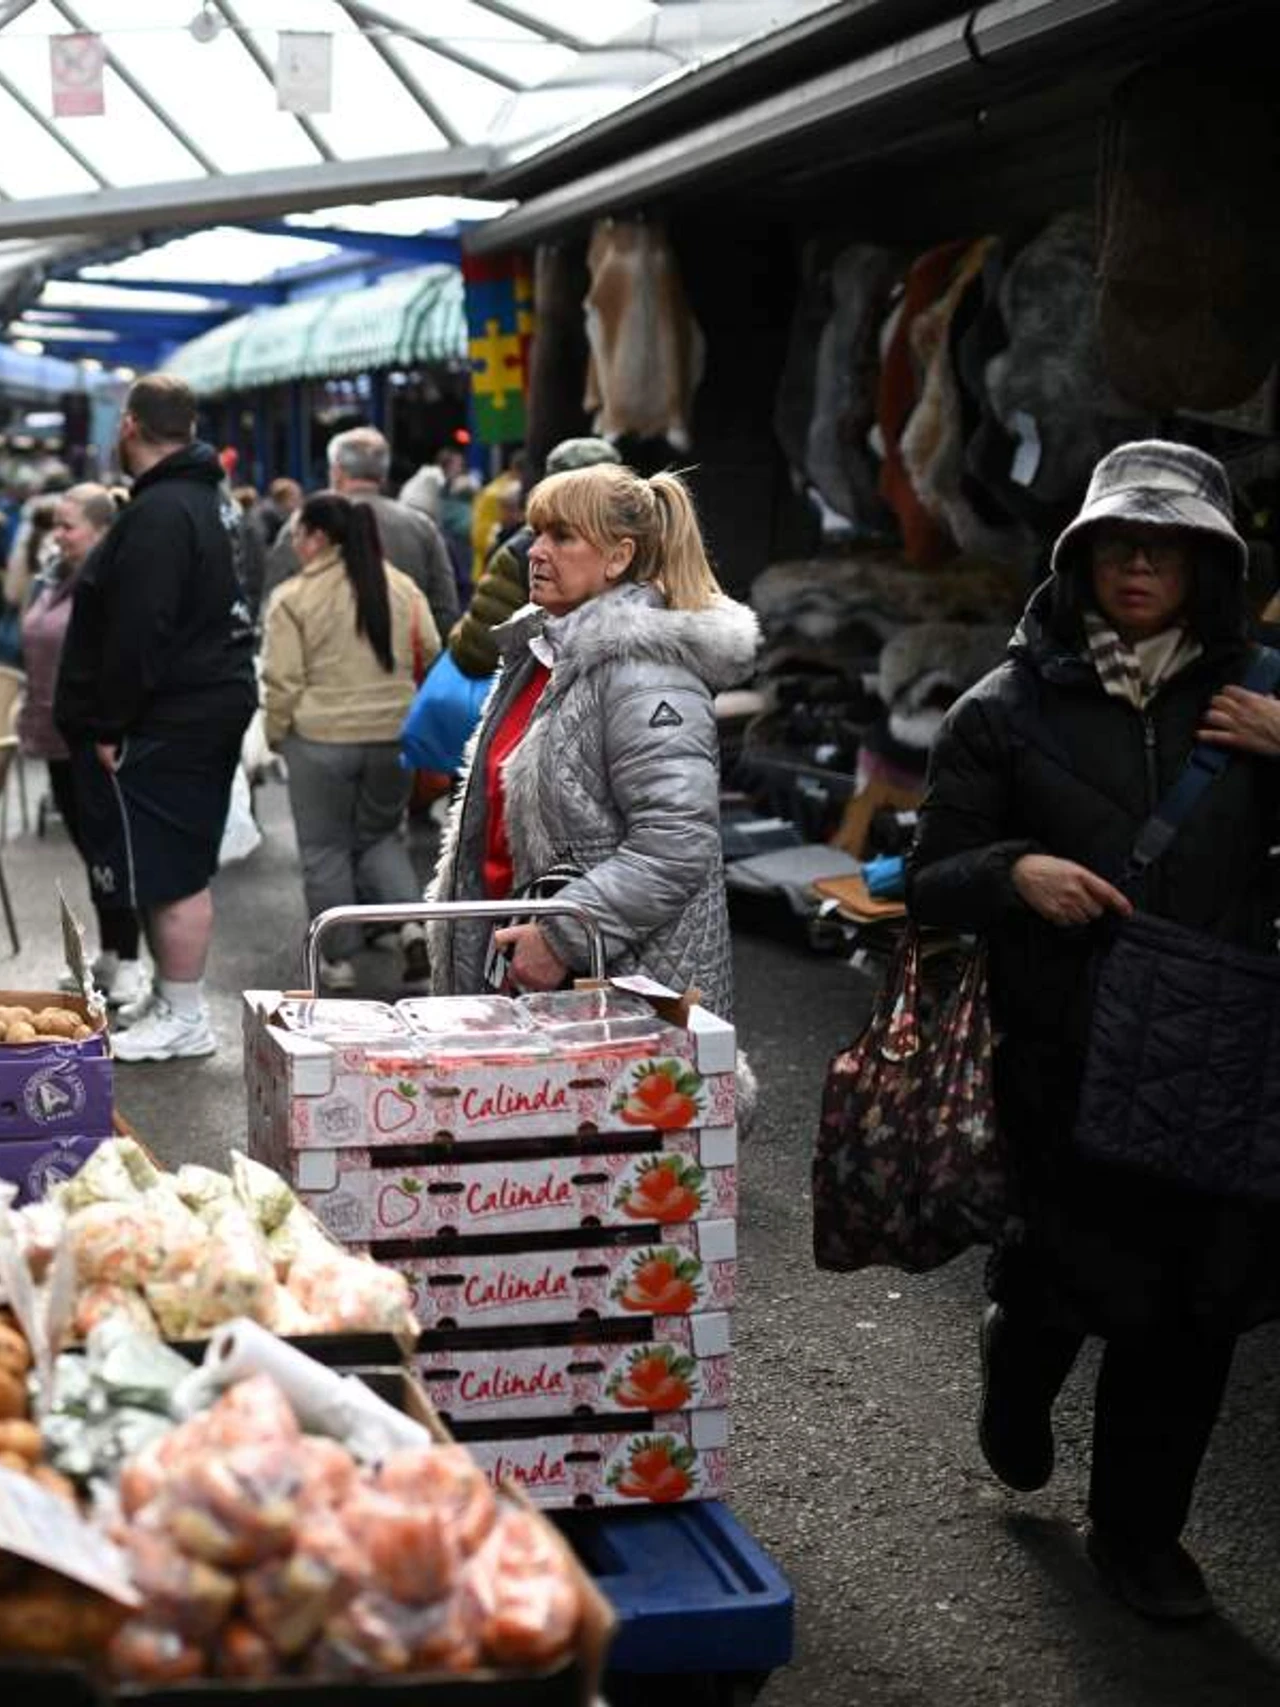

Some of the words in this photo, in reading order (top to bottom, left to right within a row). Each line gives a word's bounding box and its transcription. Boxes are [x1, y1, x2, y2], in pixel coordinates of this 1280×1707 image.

[463, 1079, 567, 1120] Calinda
[467, 1174, 571, 1214] Calinda
[465, 1266, 567, 1306] Calinda
[460, 1363, 563, 1401] Calinda
[485, 1452, 566, 1488] linda
